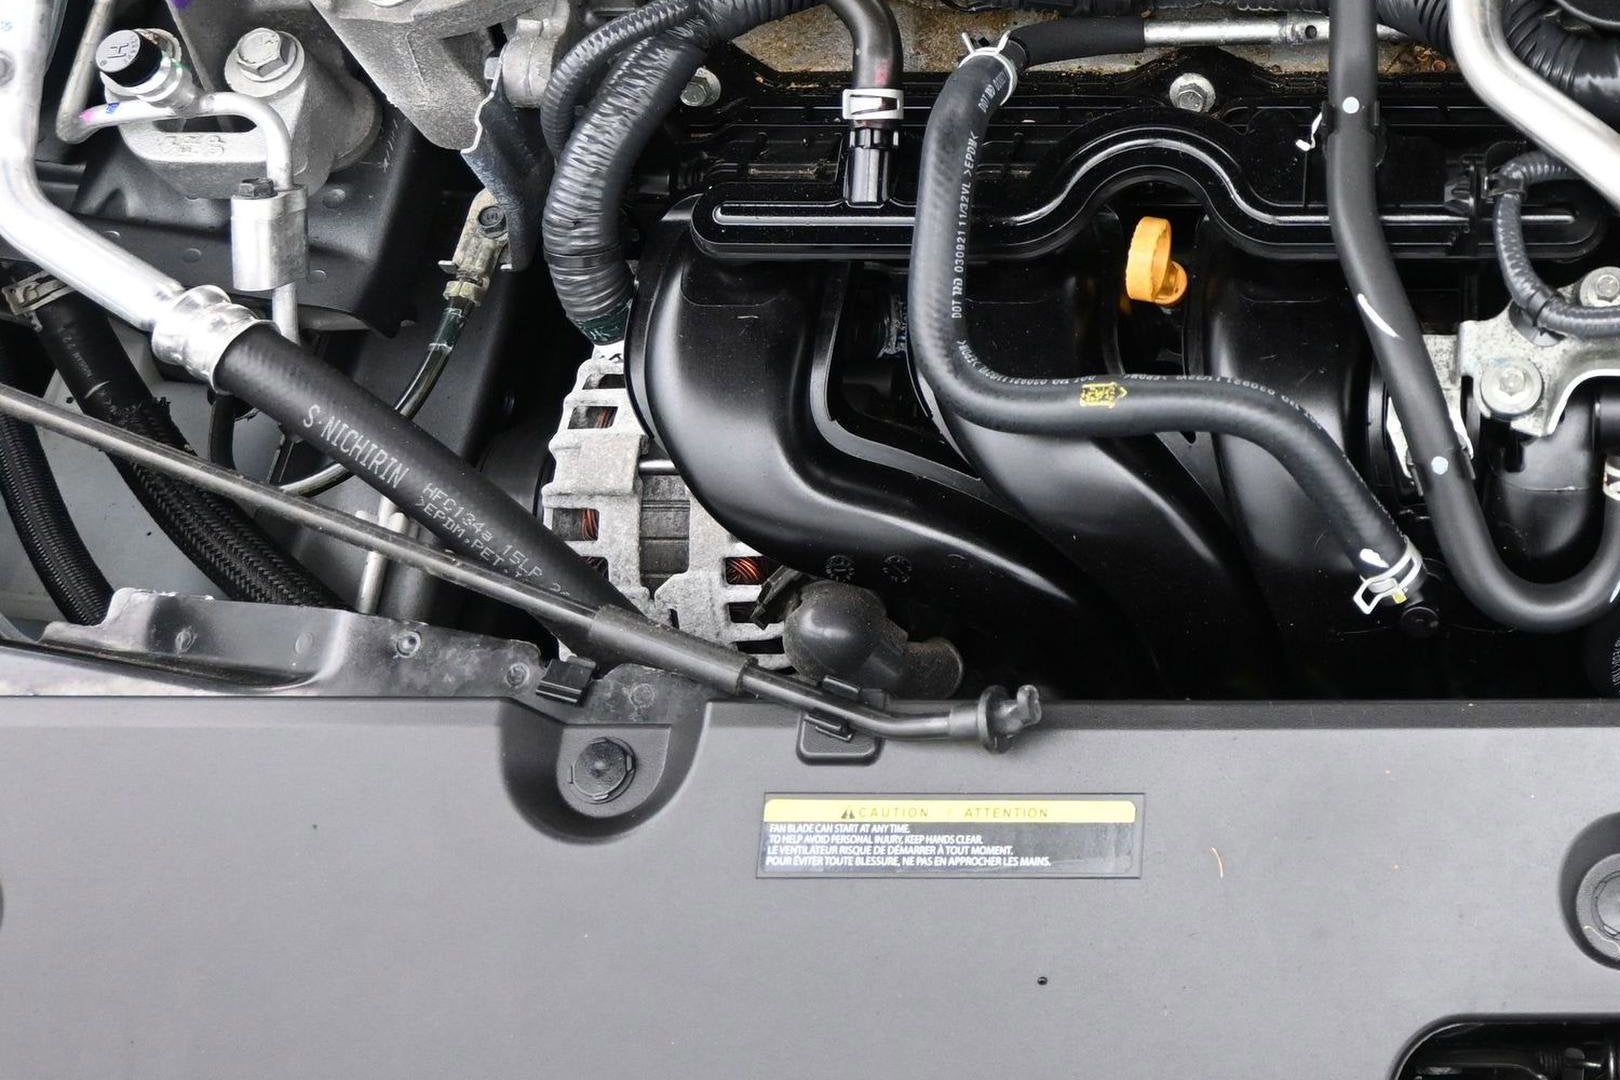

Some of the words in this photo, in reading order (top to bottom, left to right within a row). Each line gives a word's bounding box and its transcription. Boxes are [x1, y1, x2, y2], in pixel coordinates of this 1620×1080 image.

[952, 300, 962, 319] DOT
[858, 807, 929, 818] CAUTION
[964, 808, 1048, 818] ATTENTION
[769, 824, 786, 833] FAN
[787, 824, 813, 833] BLADE
[815, 824, 833, 833] CAN
[835, 824, 858, 833] START
[860, 824, 870, 833] AT
[872, 824, 889, 833] ANY
[890, 824, 910, 833] TIME.
[769, 835, 781, 844] TO
[782, 835, 802, 844] HELP
[804, 835, 830, 844] AVOID
[831, 835, 873, 844] PERSONAL
[905, 835, 925, 844] KEEP
[925, 835, 955, 844] HANDS
[956, 835, 983, 844] CLEAR.
[767, 846, 779, 855] LE
[779, 846, 838, 855] VENTILATEUR
[839, 846, 870, 855] RISQUE
[874, 846, 886, 855] DE
[887, 844, 935, 855] DÉMARRER
[937, 845, 944, 855] À
[945, 846, 970, 855] TOUT
[971, 846, 1013, 855] MOMENT.
[766, 856, 791, 865] POUR
[794, 855, 824, 865] ÉVITER
[825, 856, 854, 865] TOUTE
[902, 856, 915, 865] NE
[917, 857, 933, 866] PAS
[934, 857, 947, 866] EN
[948, 857, 1002, 866] APPROCHER
[1003, 857, 1018, 866] LES
